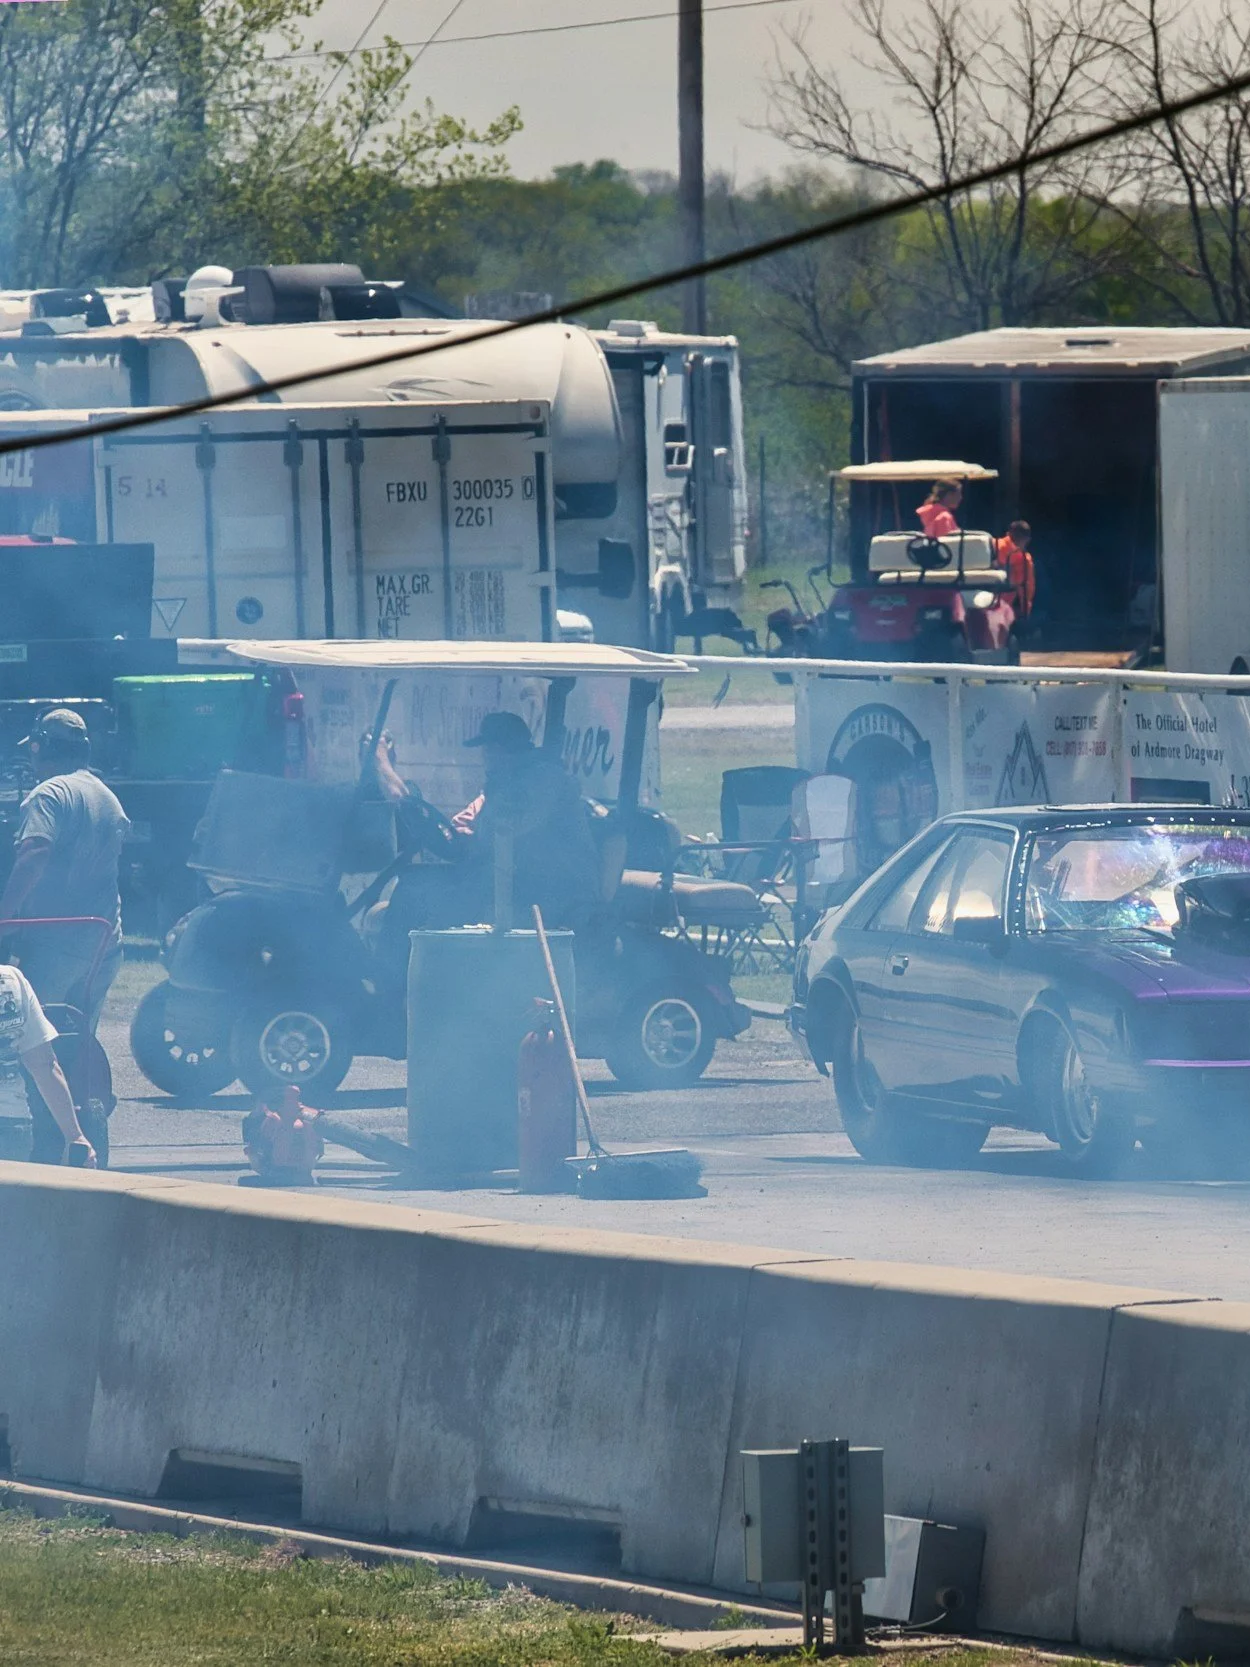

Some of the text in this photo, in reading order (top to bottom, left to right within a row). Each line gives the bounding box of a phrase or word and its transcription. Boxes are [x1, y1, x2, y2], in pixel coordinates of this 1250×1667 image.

[386, 481, 428, 502] FBXU
[453, 479, 513, 500] 300035
[455, 506, 493, 527] 22G1
[376, 574, 433, 595] MAX.GR.
[377, 596, 411, 616] TARE
[377, 617, 400, 638] NET
[1135, 713, 1217, 733] The Official Hotel
[1131, 741, 1224, 767] of Ardmore Dragway
